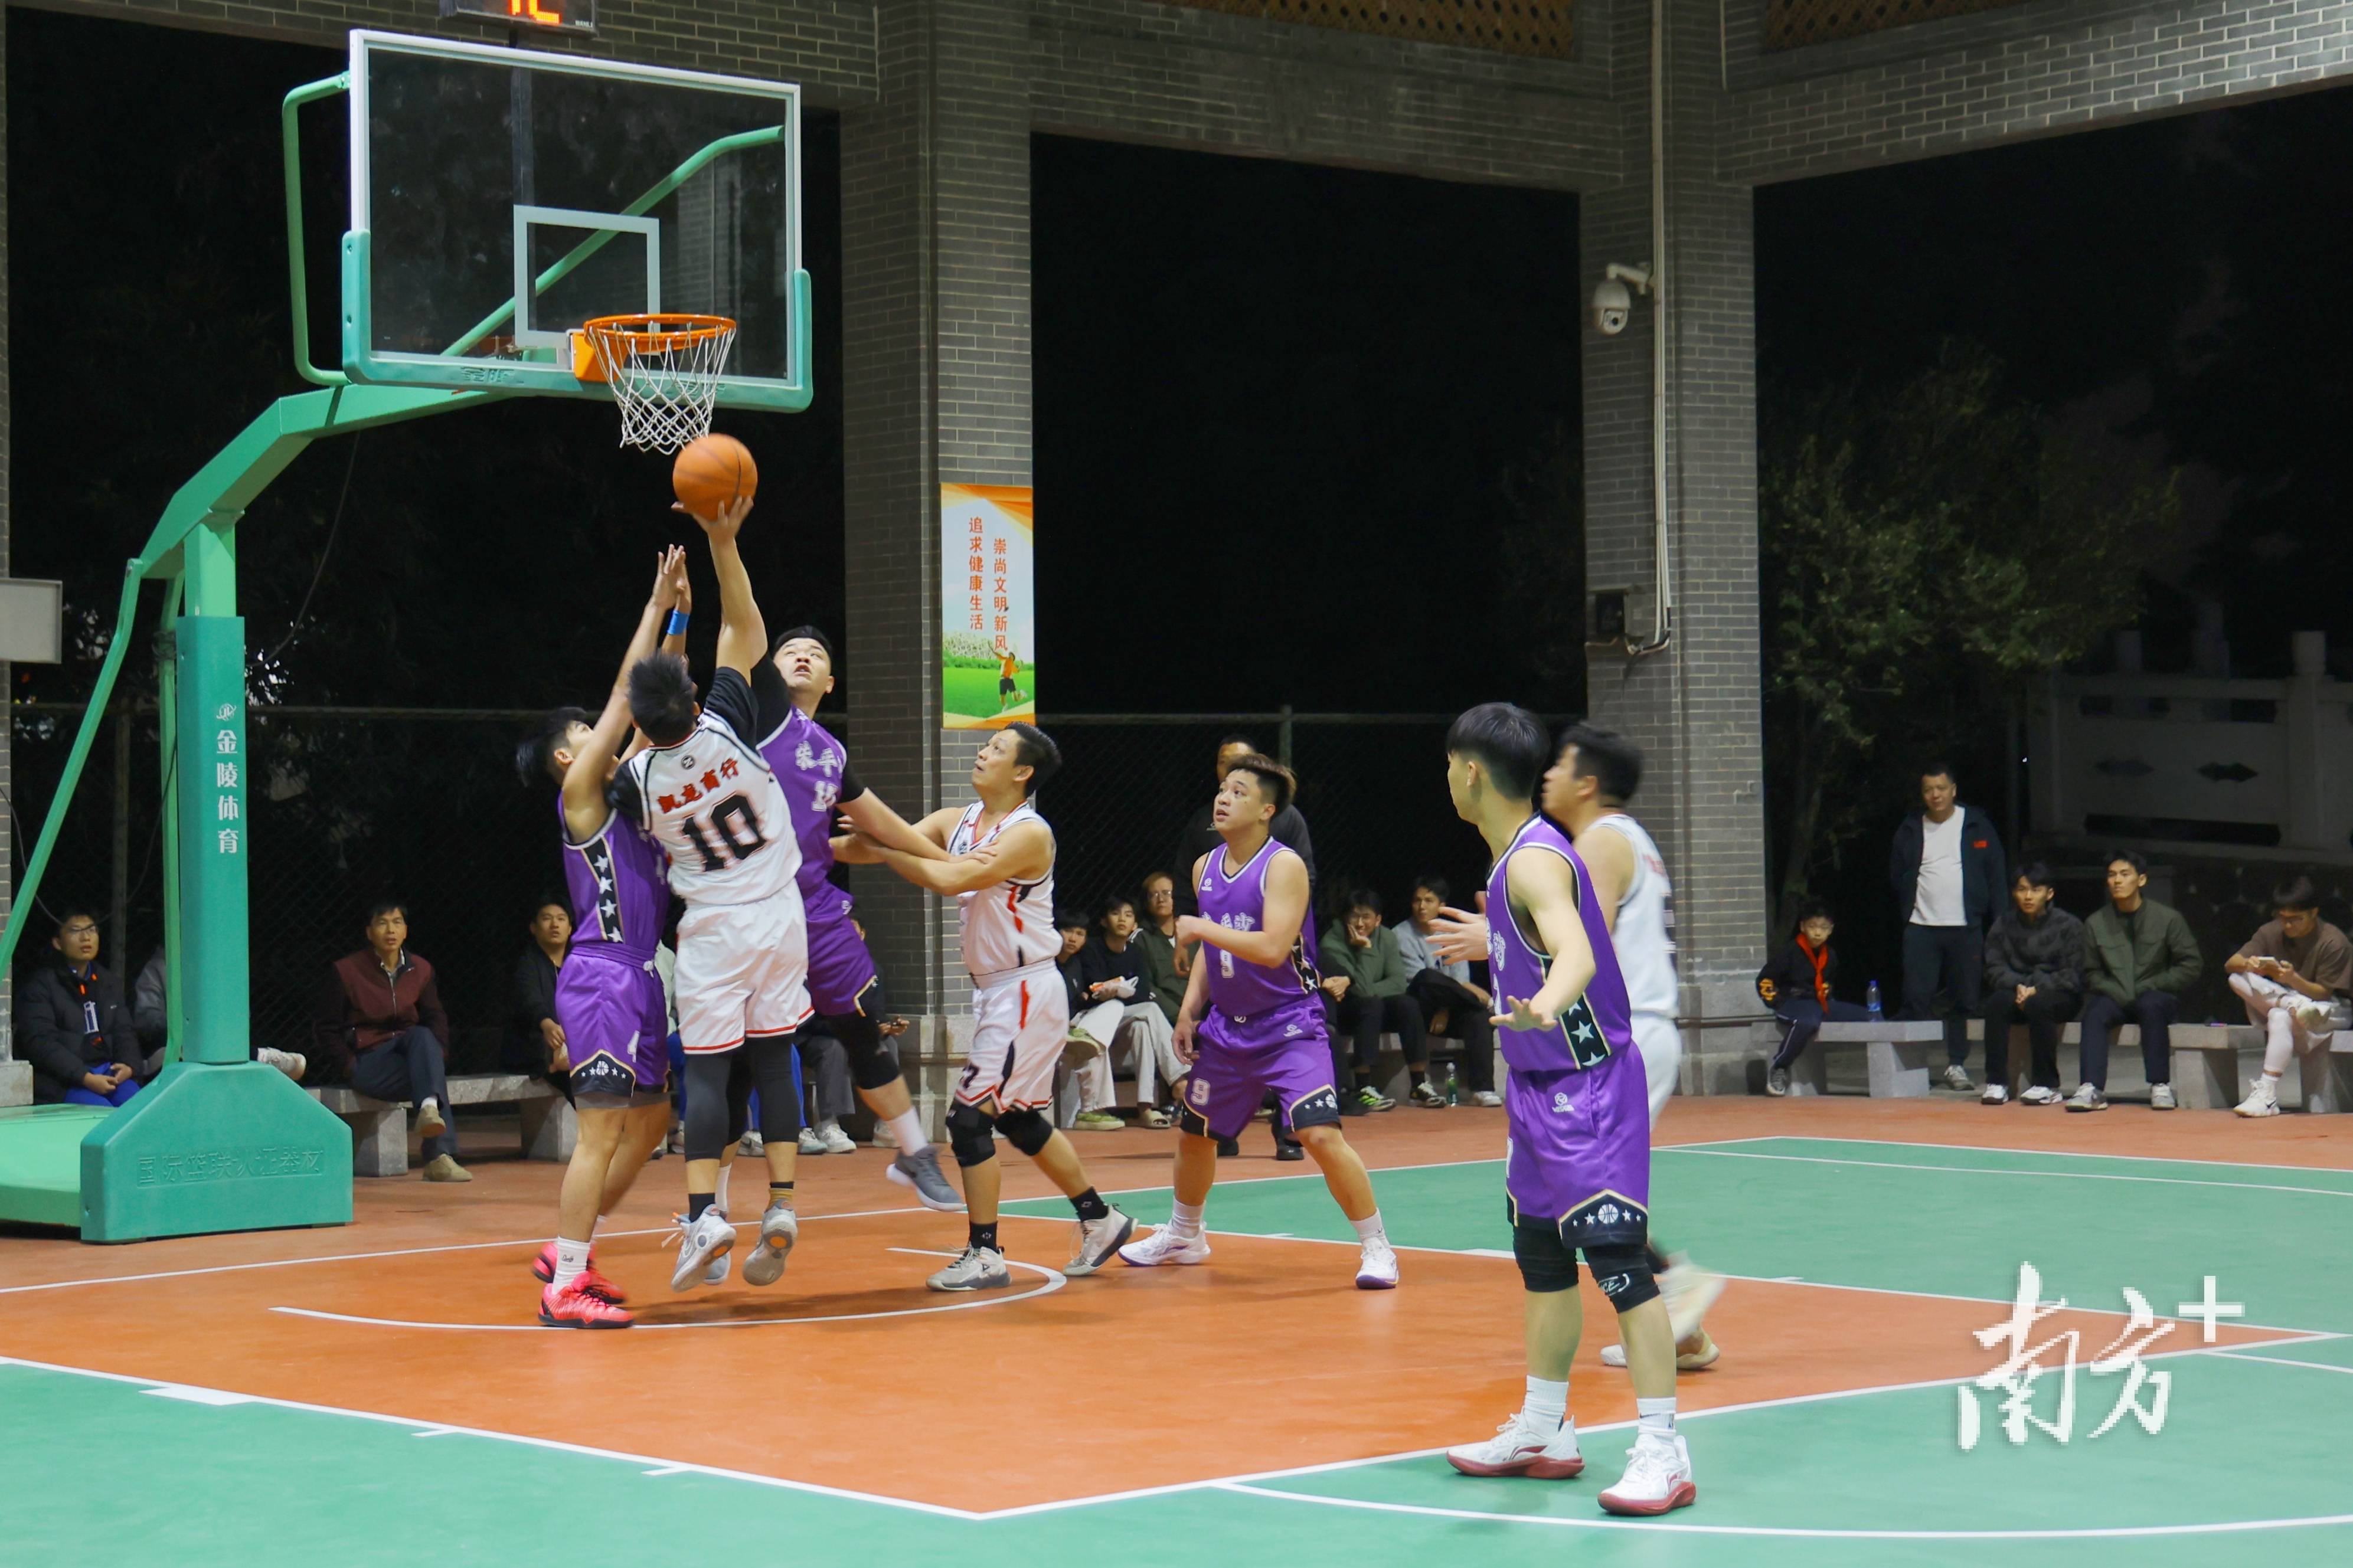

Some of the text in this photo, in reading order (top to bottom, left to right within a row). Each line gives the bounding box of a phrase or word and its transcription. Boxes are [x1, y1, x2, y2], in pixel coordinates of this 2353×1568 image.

[968, 516, 984, 631] 追求健康生活
[994, 538, 1008, 651] 崇尚文明新风
[216, 729, 239, 854] 金陵体育
[681, 791, 770, 872] 10
[1191, 1078, 1211, 1105] 9
[138, 1147, 323, 1184] 国际篮联认证器材
